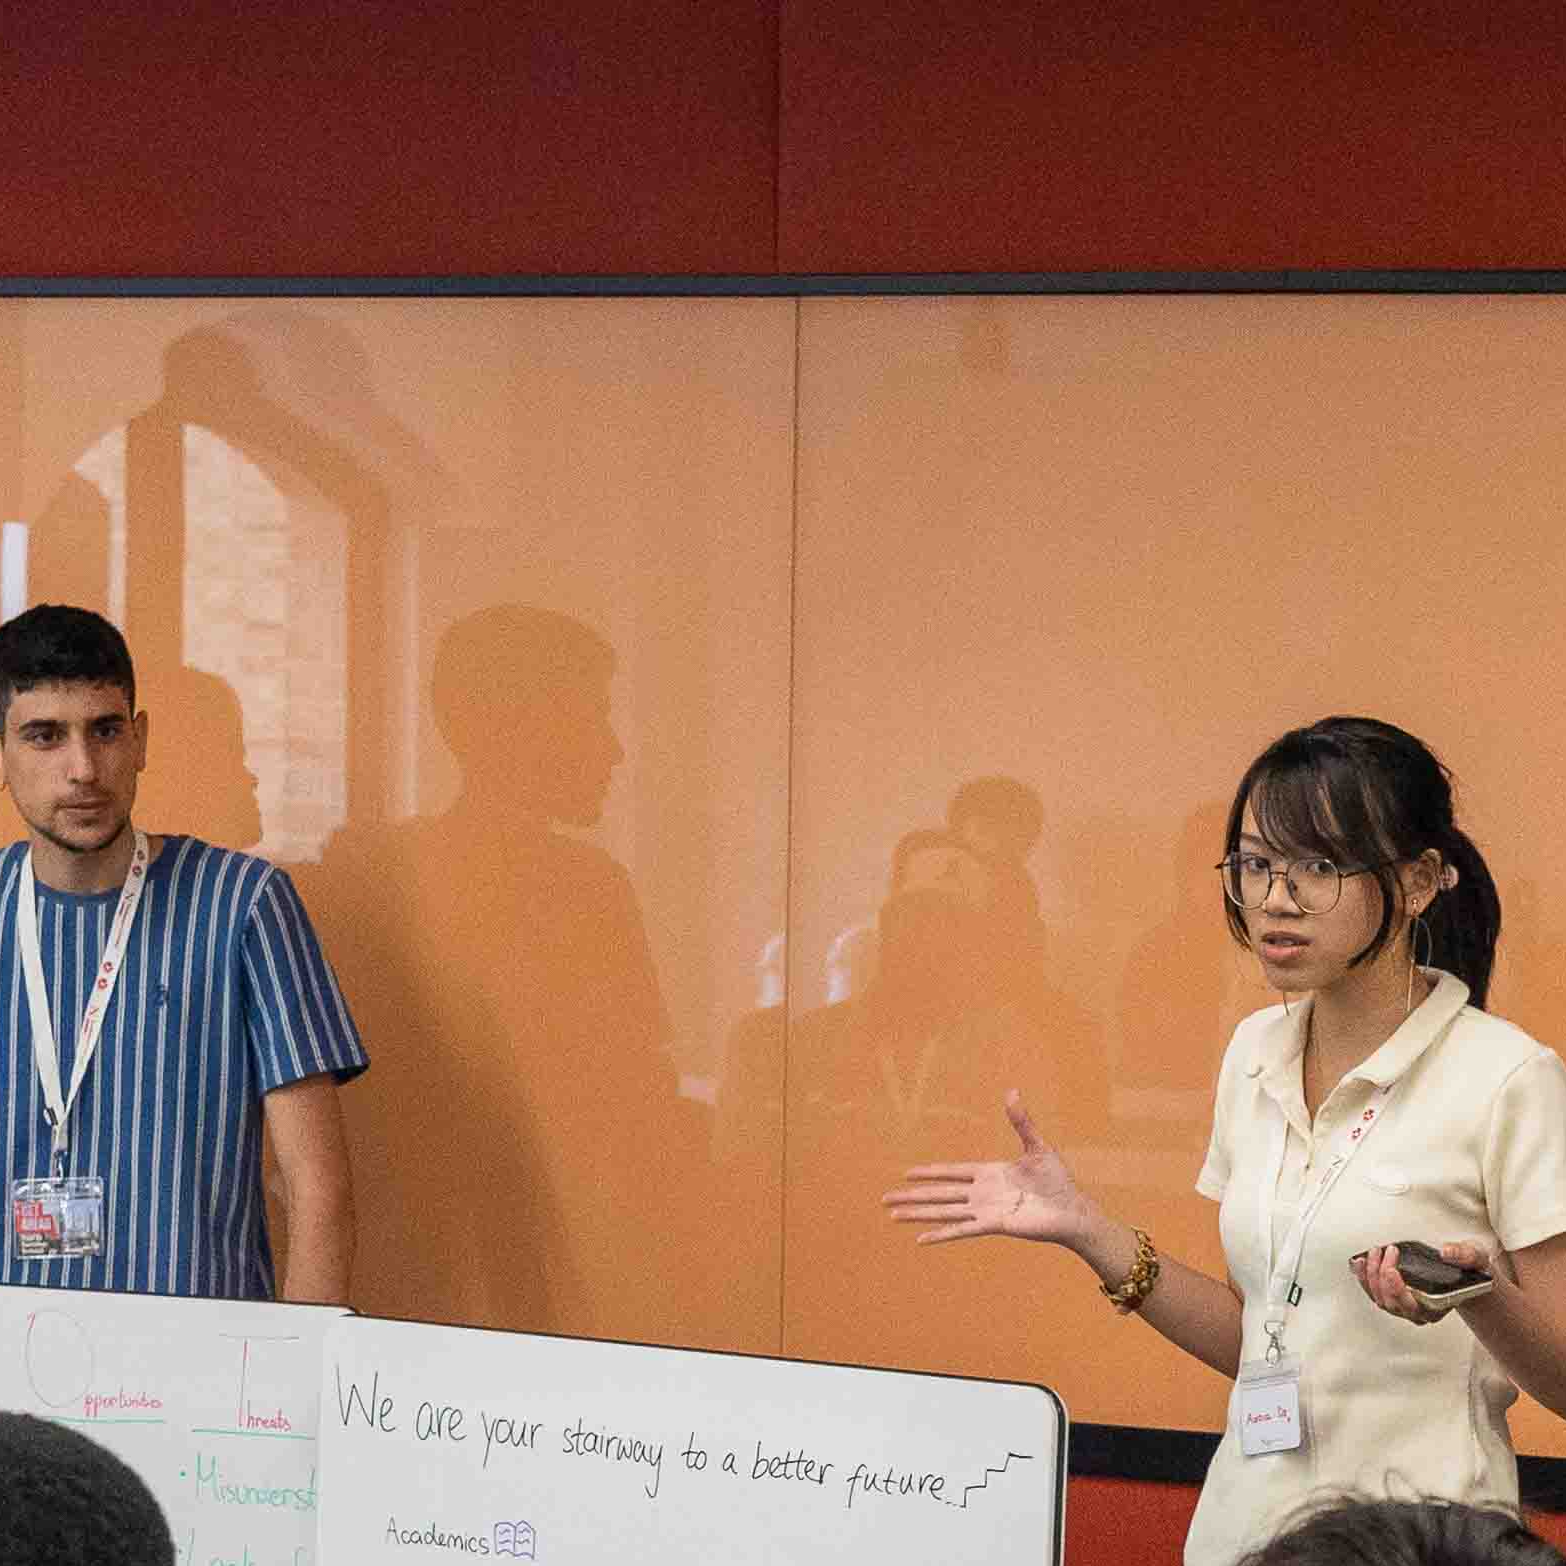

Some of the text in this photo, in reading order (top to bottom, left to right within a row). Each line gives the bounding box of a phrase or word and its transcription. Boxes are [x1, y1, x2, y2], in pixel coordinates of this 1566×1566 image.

[334, 1361, 949, 1510] We are your stairway to a better future
[385, 1515, 491, 1556] Academics
